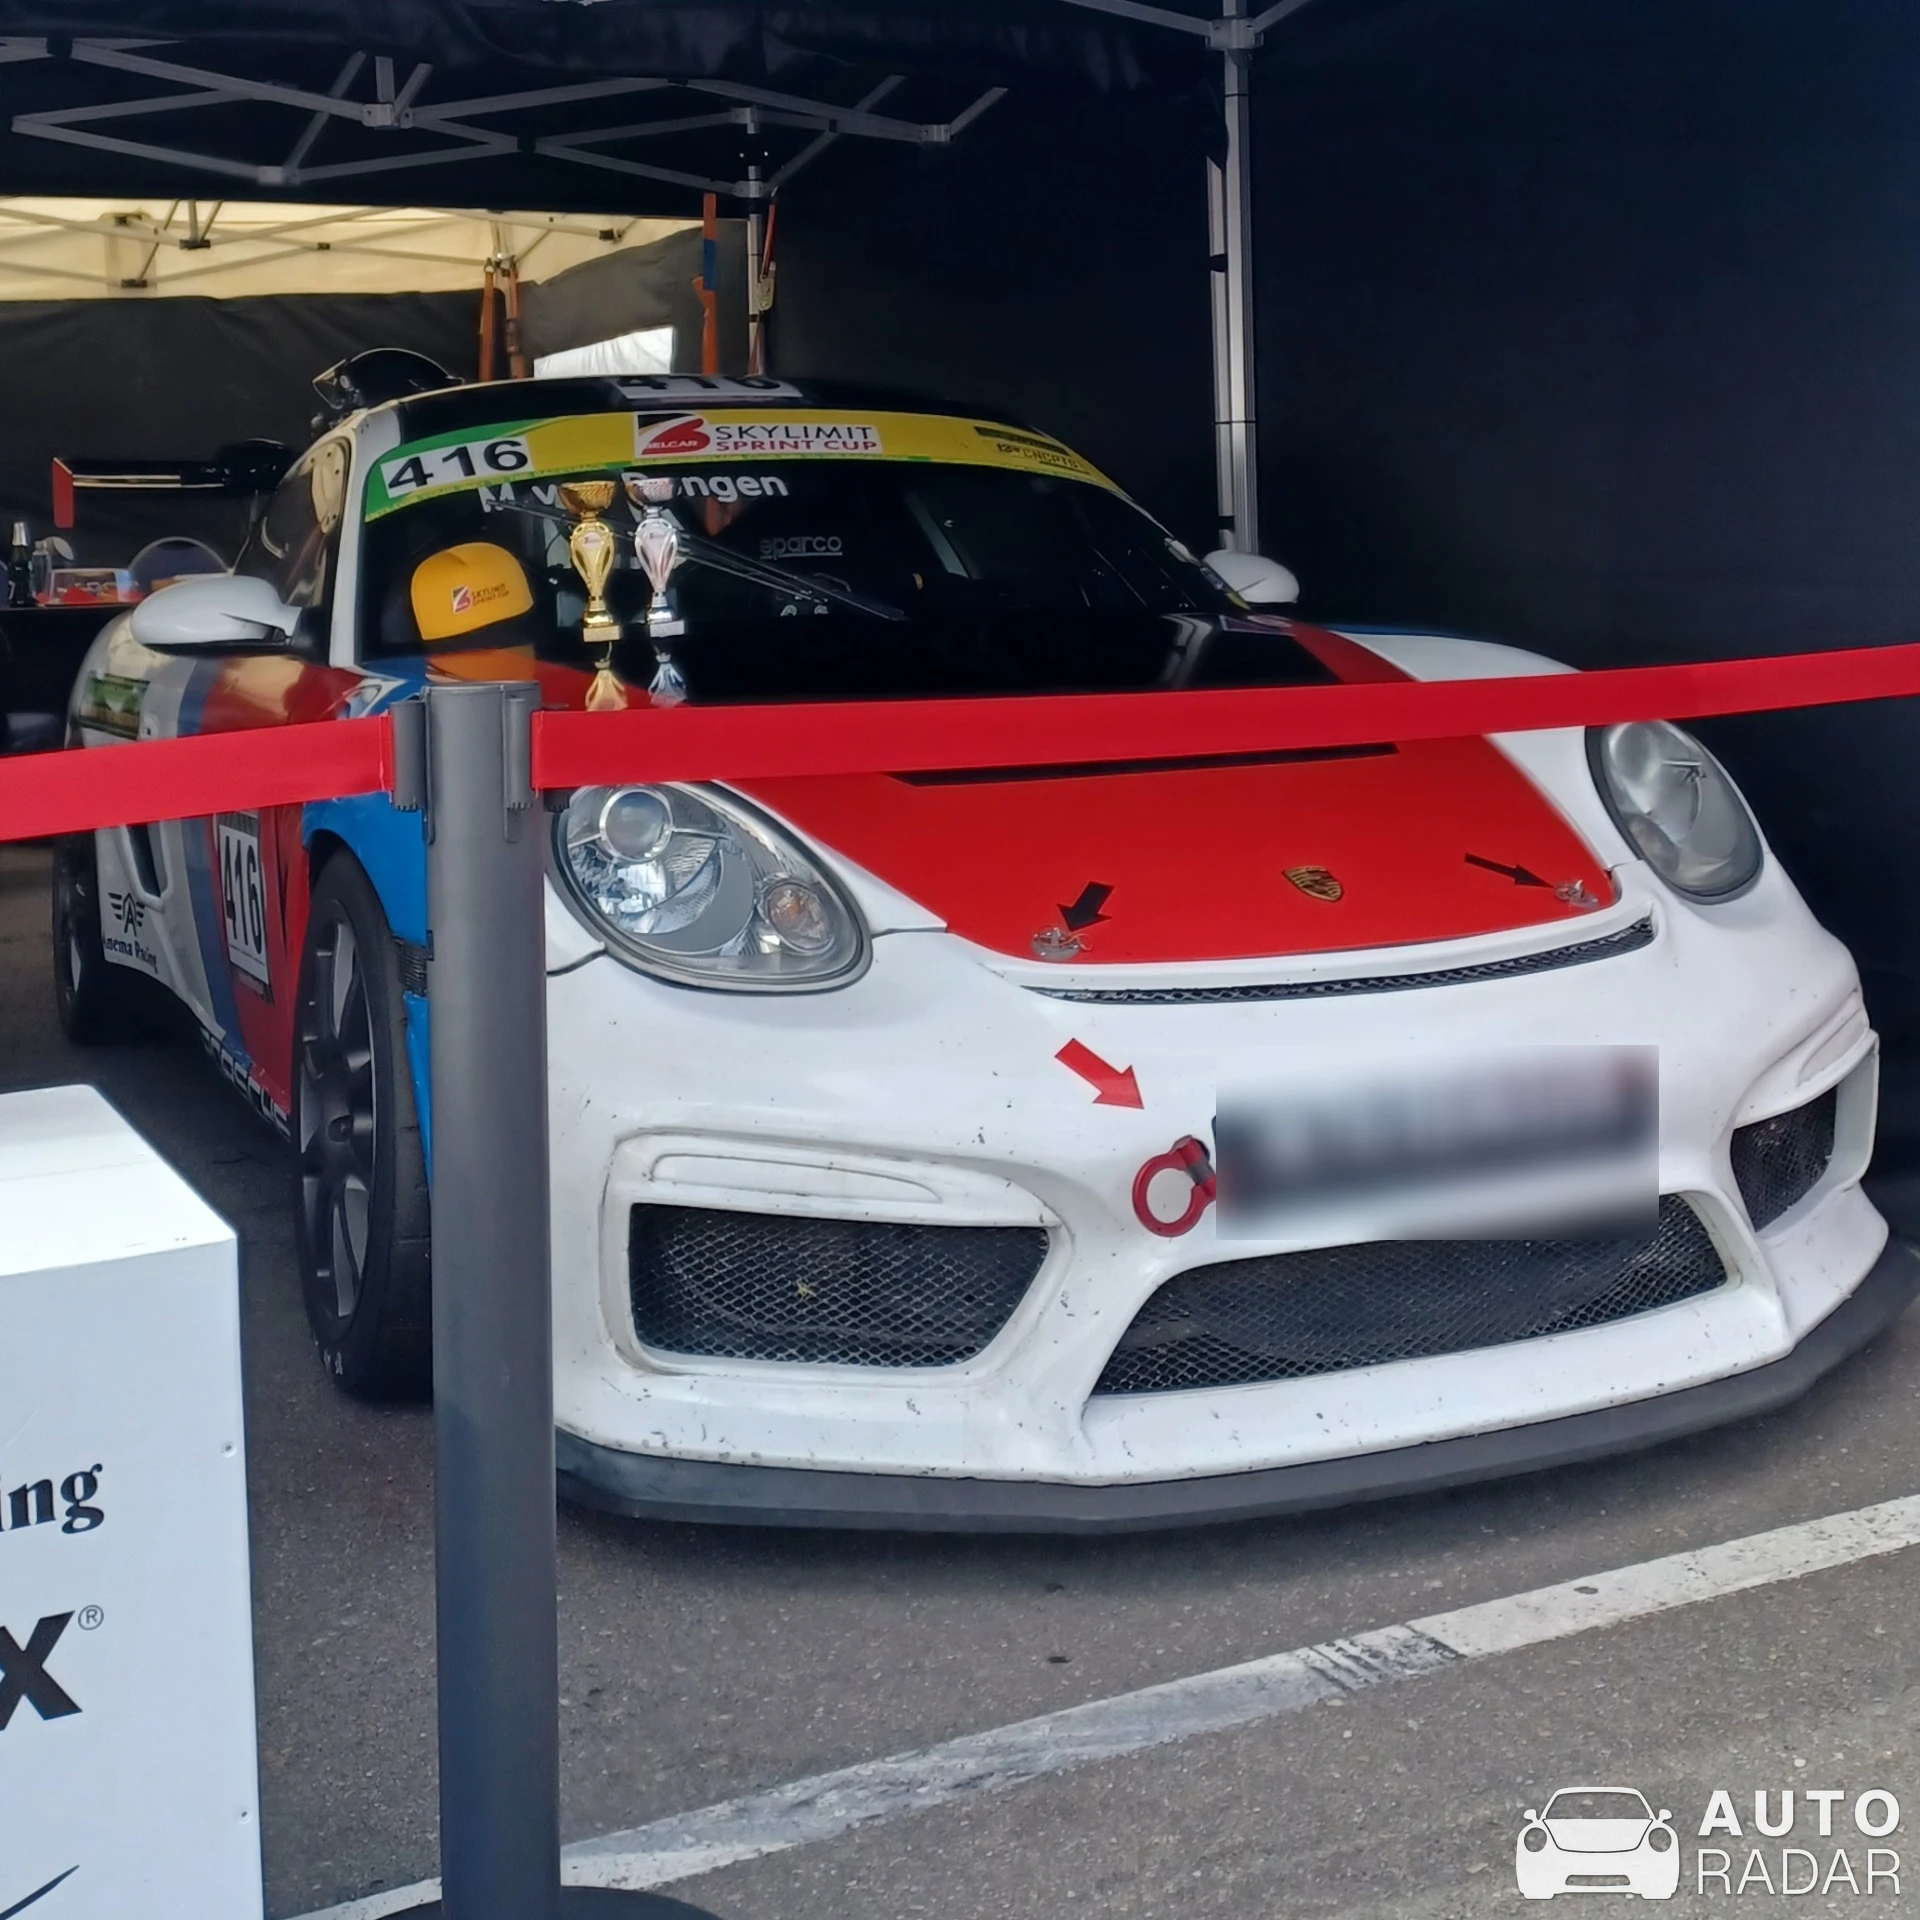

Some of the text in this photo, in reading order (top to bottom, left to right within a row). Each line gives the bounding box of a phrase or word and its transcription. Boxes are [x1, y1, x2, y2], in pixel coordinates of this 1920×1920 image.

[715, 425, 873, 441] SKYLIMIT
[715, 440, 878, 452] SPRINT CUP
[387, 440, 529, 490] 416
[621, 472, 789, 503] ngen
[224, 835, 262, 955] 416
